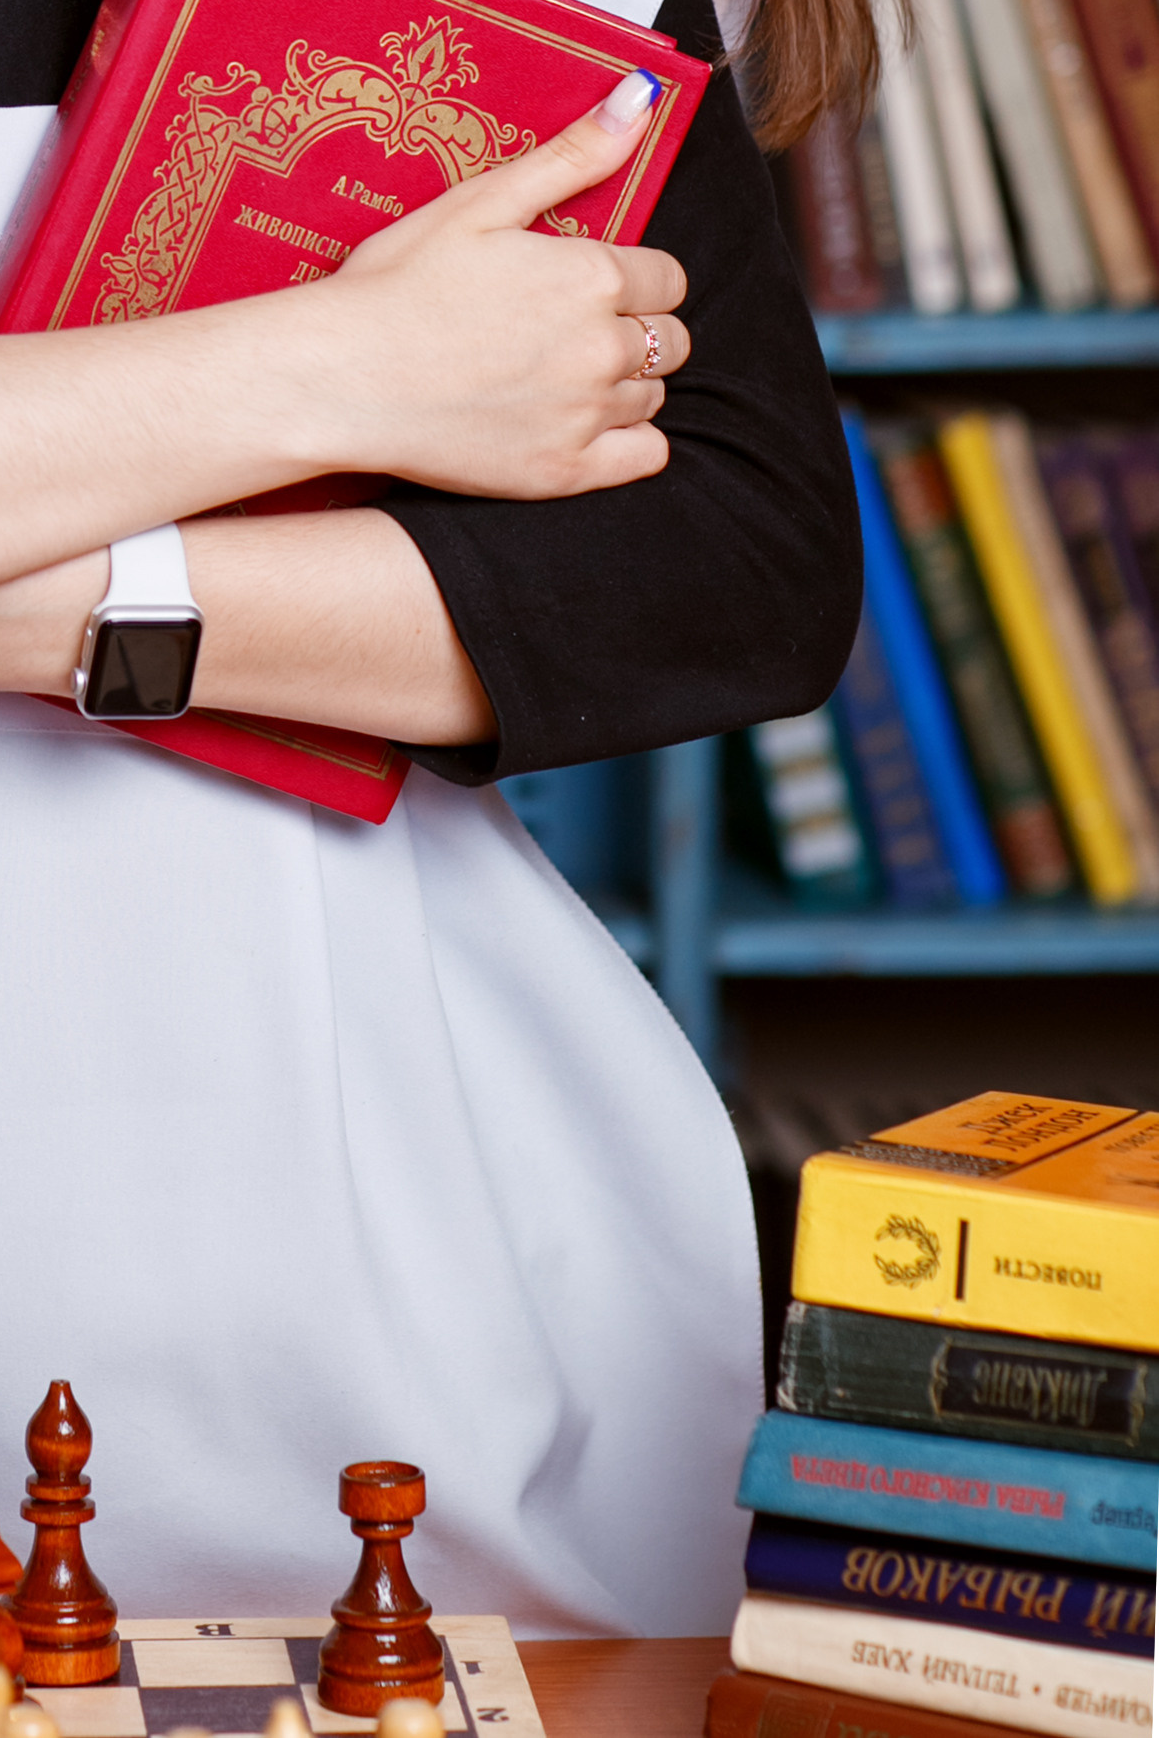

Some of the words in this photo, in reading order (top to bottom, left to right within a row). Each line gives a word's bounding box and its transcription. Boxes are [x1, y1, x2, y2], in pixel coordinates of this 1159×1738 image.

[331, 175, 404, 217] А.Рамбо
[981, 1109, 1100, 1152] ЛОНДОН
[994, 1256, 1102, 1291] ПОВЕСТИ
[791, 1455, 870, 1493] ЦВЕТА
[870, 1466, 990, 1508] КРАСНОГО
[841, 1546, 1071, 1623] РЫБАКОВ
[851, 1640, 913, 1673] ХЛЕБ
[922, 1653, 1020, 1699] ТЕПЛЫЙ
[1054, 1683, 1152, 1728] ОДИЧЕВ
